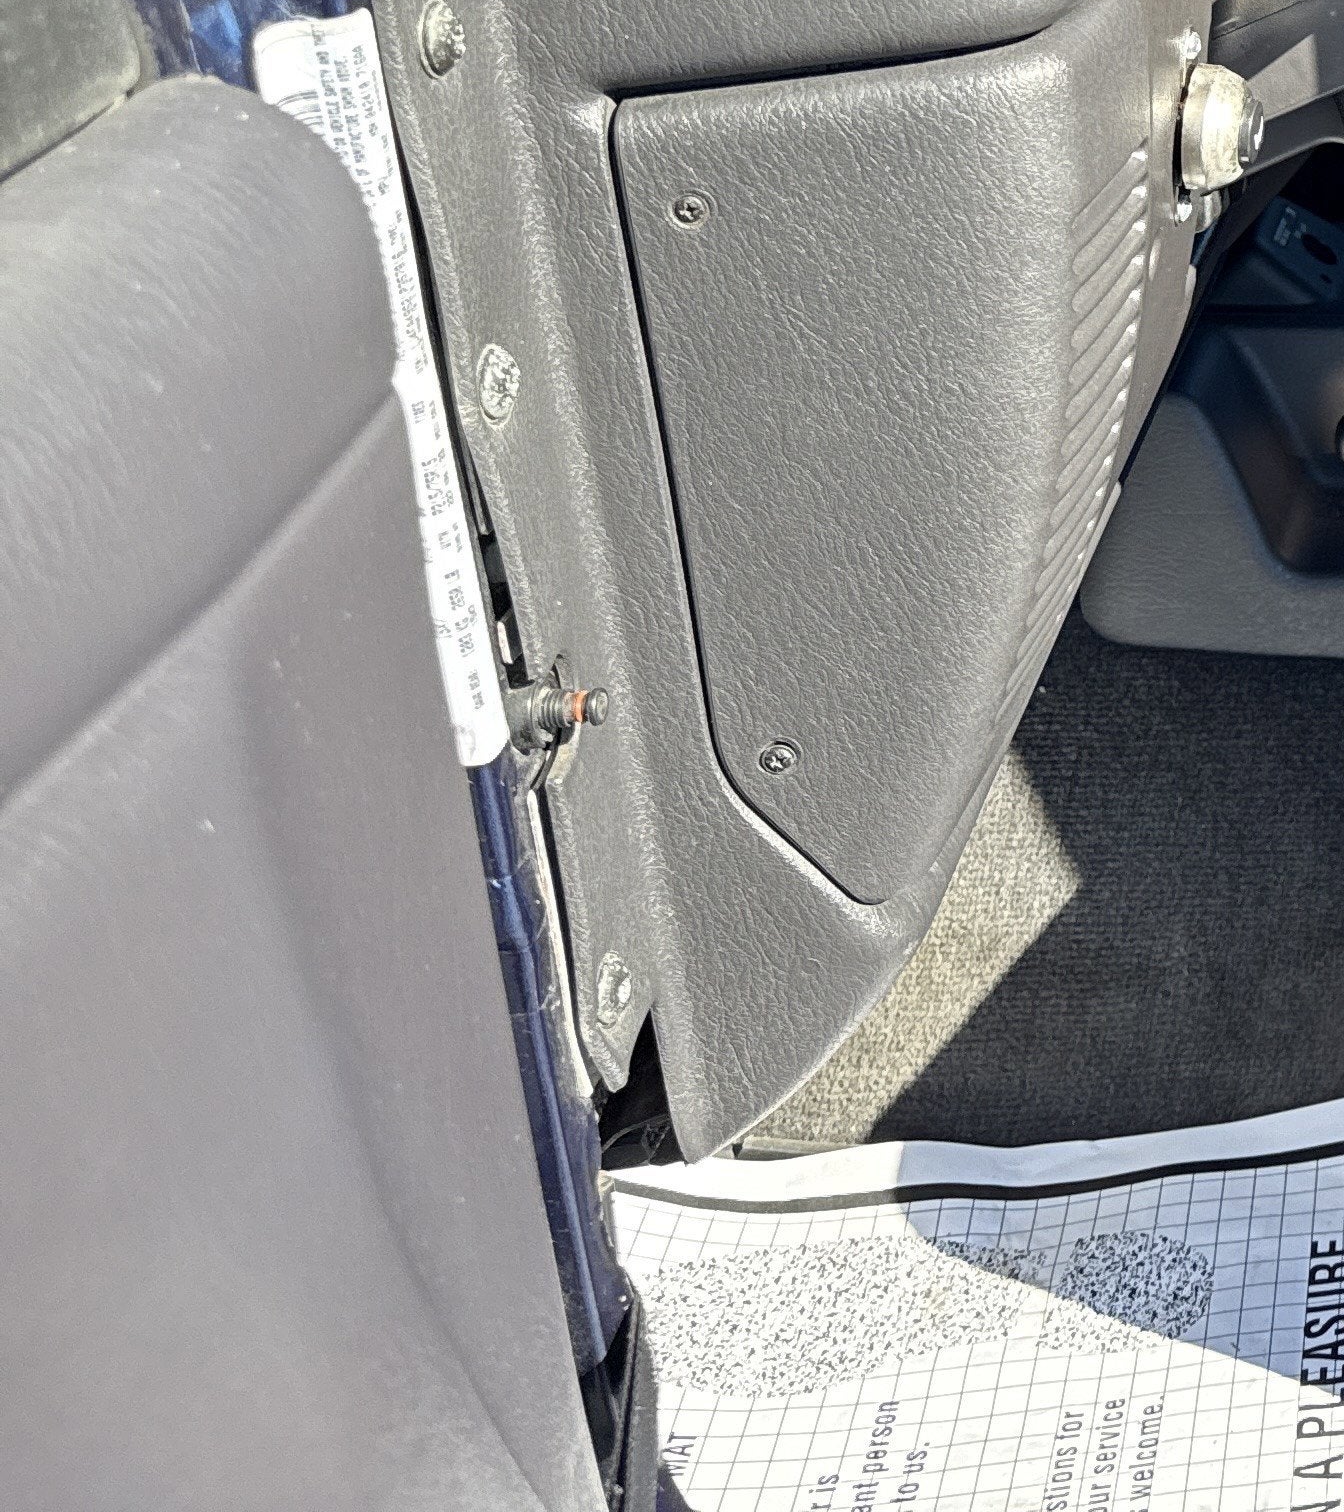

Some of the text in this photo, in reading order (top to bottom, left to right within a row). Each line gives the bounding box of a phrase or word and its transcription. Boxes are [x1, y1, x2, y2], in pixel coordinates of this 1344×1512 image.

[862, 1401, 900, 1476] person
[1054, 1411, 1084, 1440] for
[1094, 1398, 1126, 1475] service
[1129, 1395, 1164, 1502] welcome.
[809, 1473, 839, 1496] is
[890, 1442, 930, 1504] to us.
[1293, 1453, 1344, 1479] A
